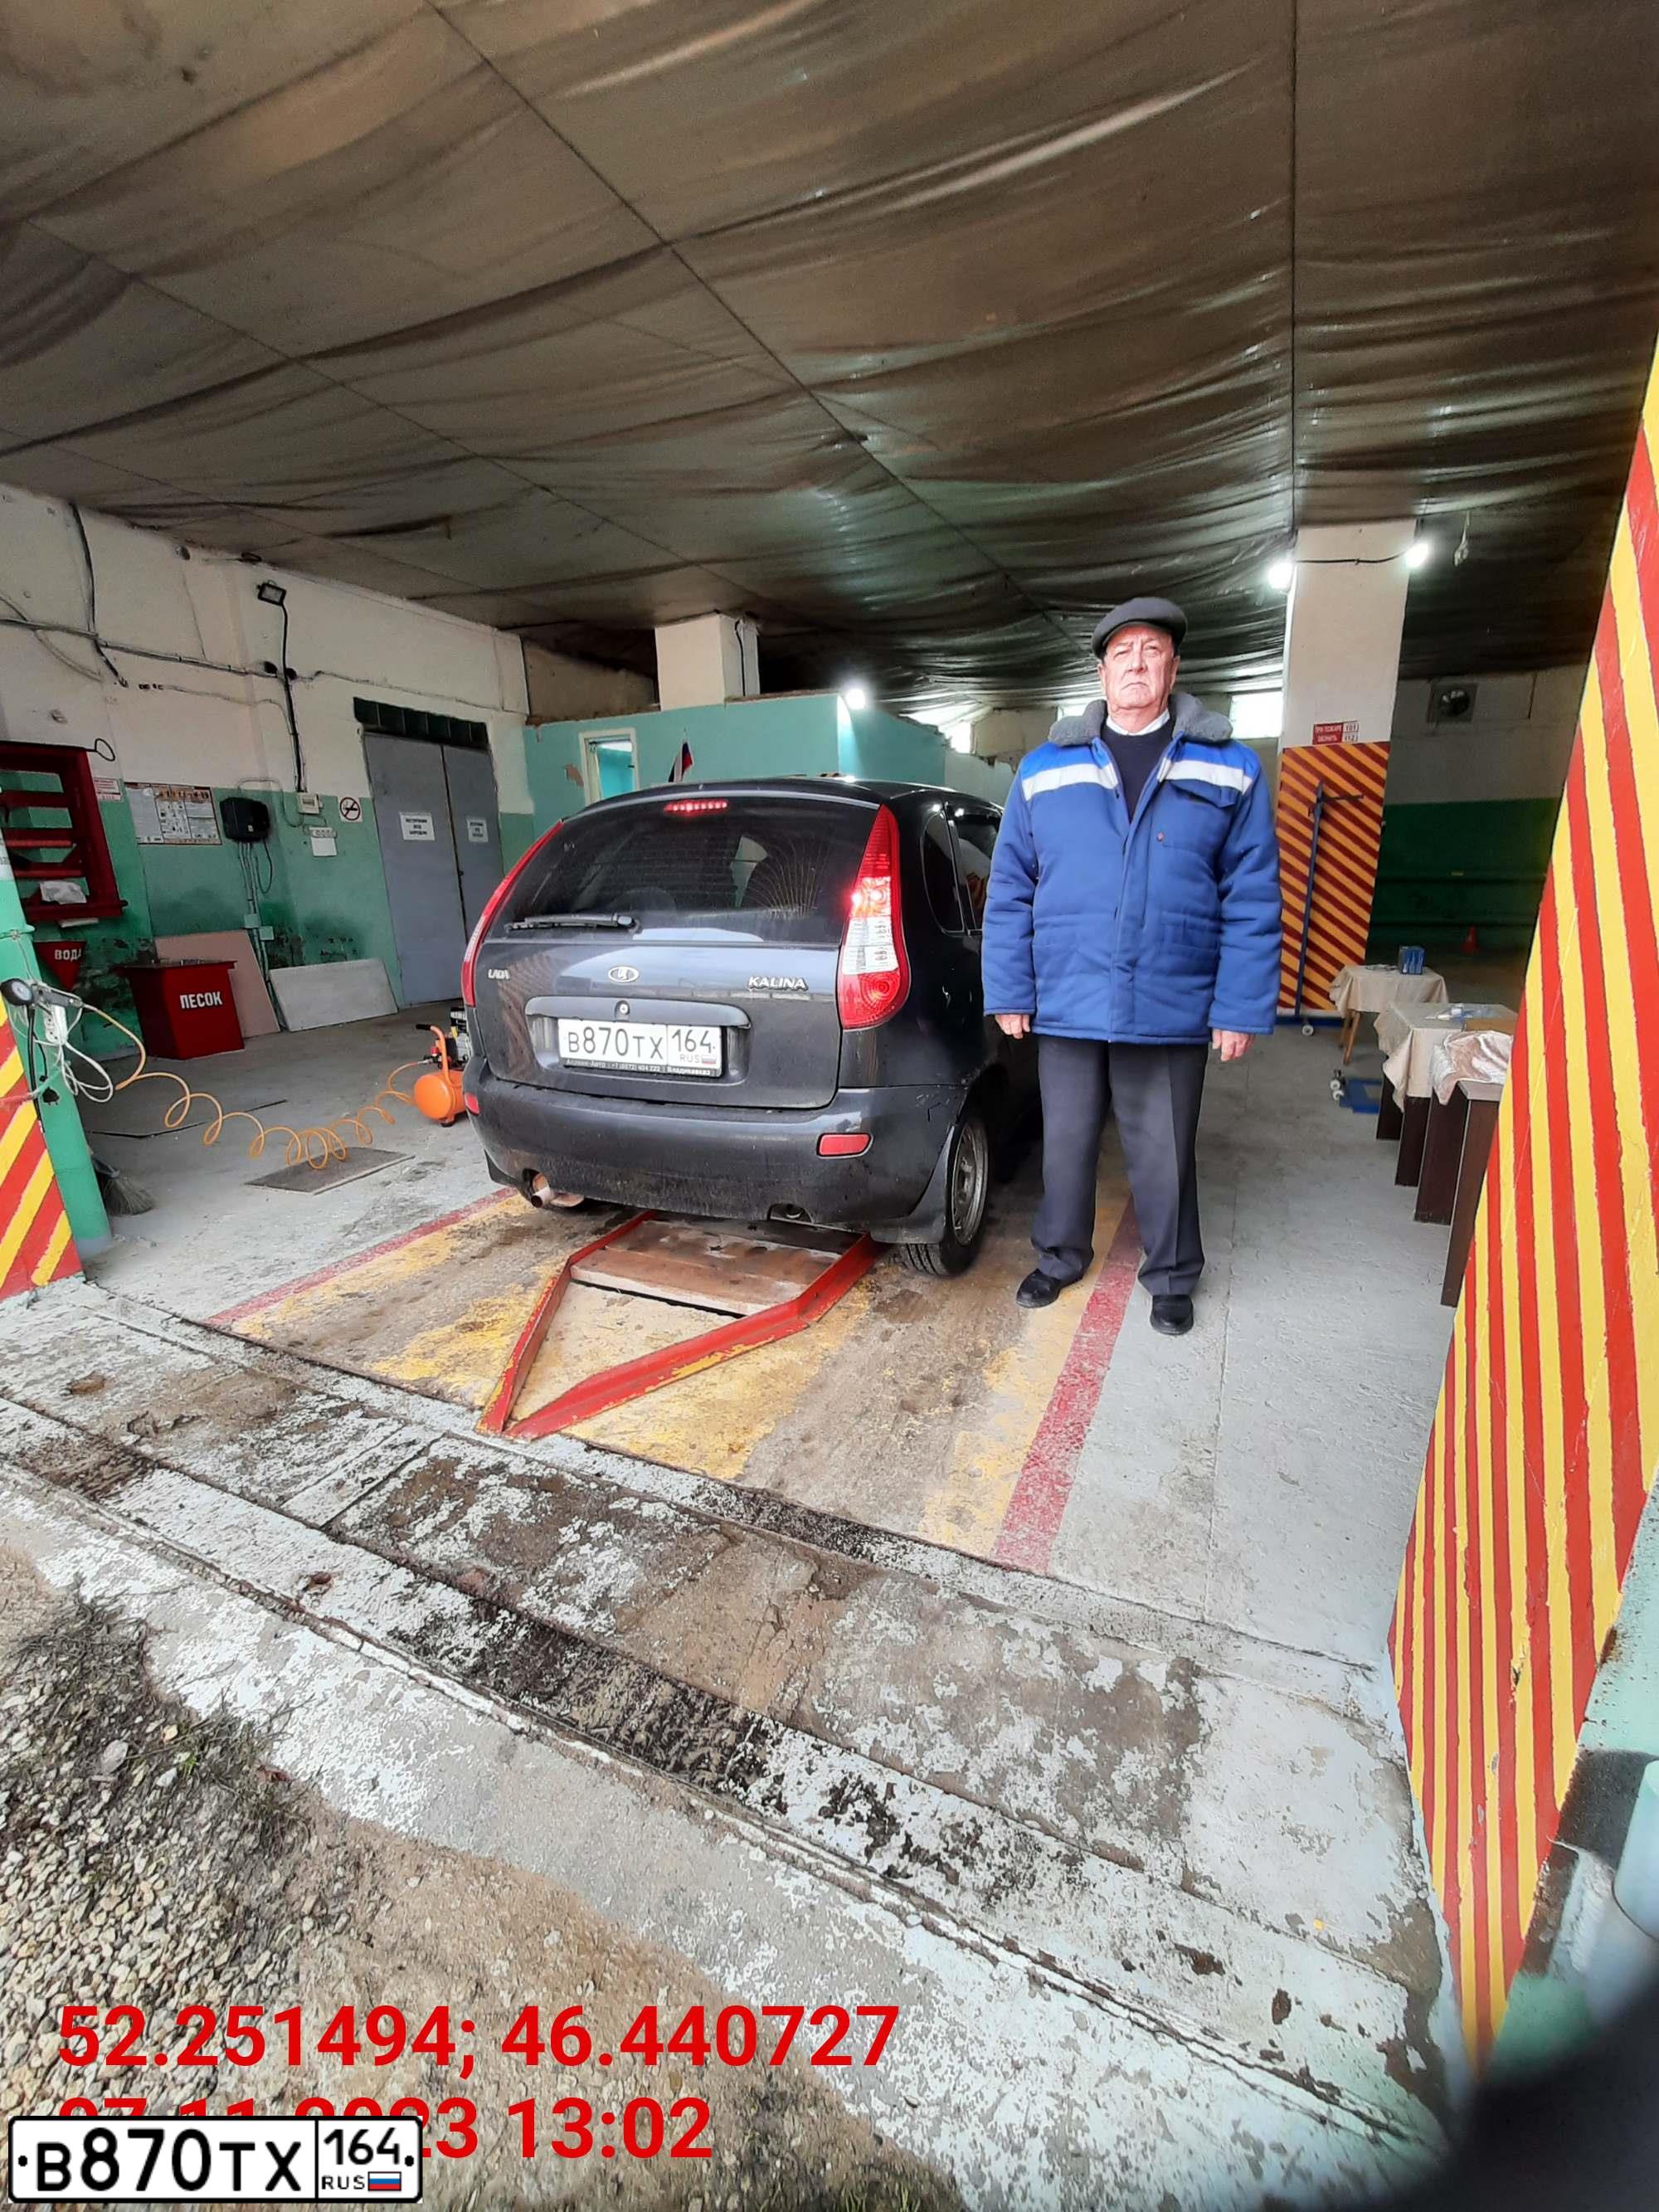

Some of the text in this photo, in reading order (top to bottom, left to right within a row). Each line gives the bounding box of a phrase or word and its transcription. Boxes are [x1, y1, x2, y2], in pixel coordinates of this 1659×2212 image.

[488, 968, 510, 980] LADA
[748, 976, 809, 992] KALINA
[180, 991, 223, 1010] ПЕСОК
[672, 1029, 712, 1054] 164
[679, 1053, 700, 1064] RUS
